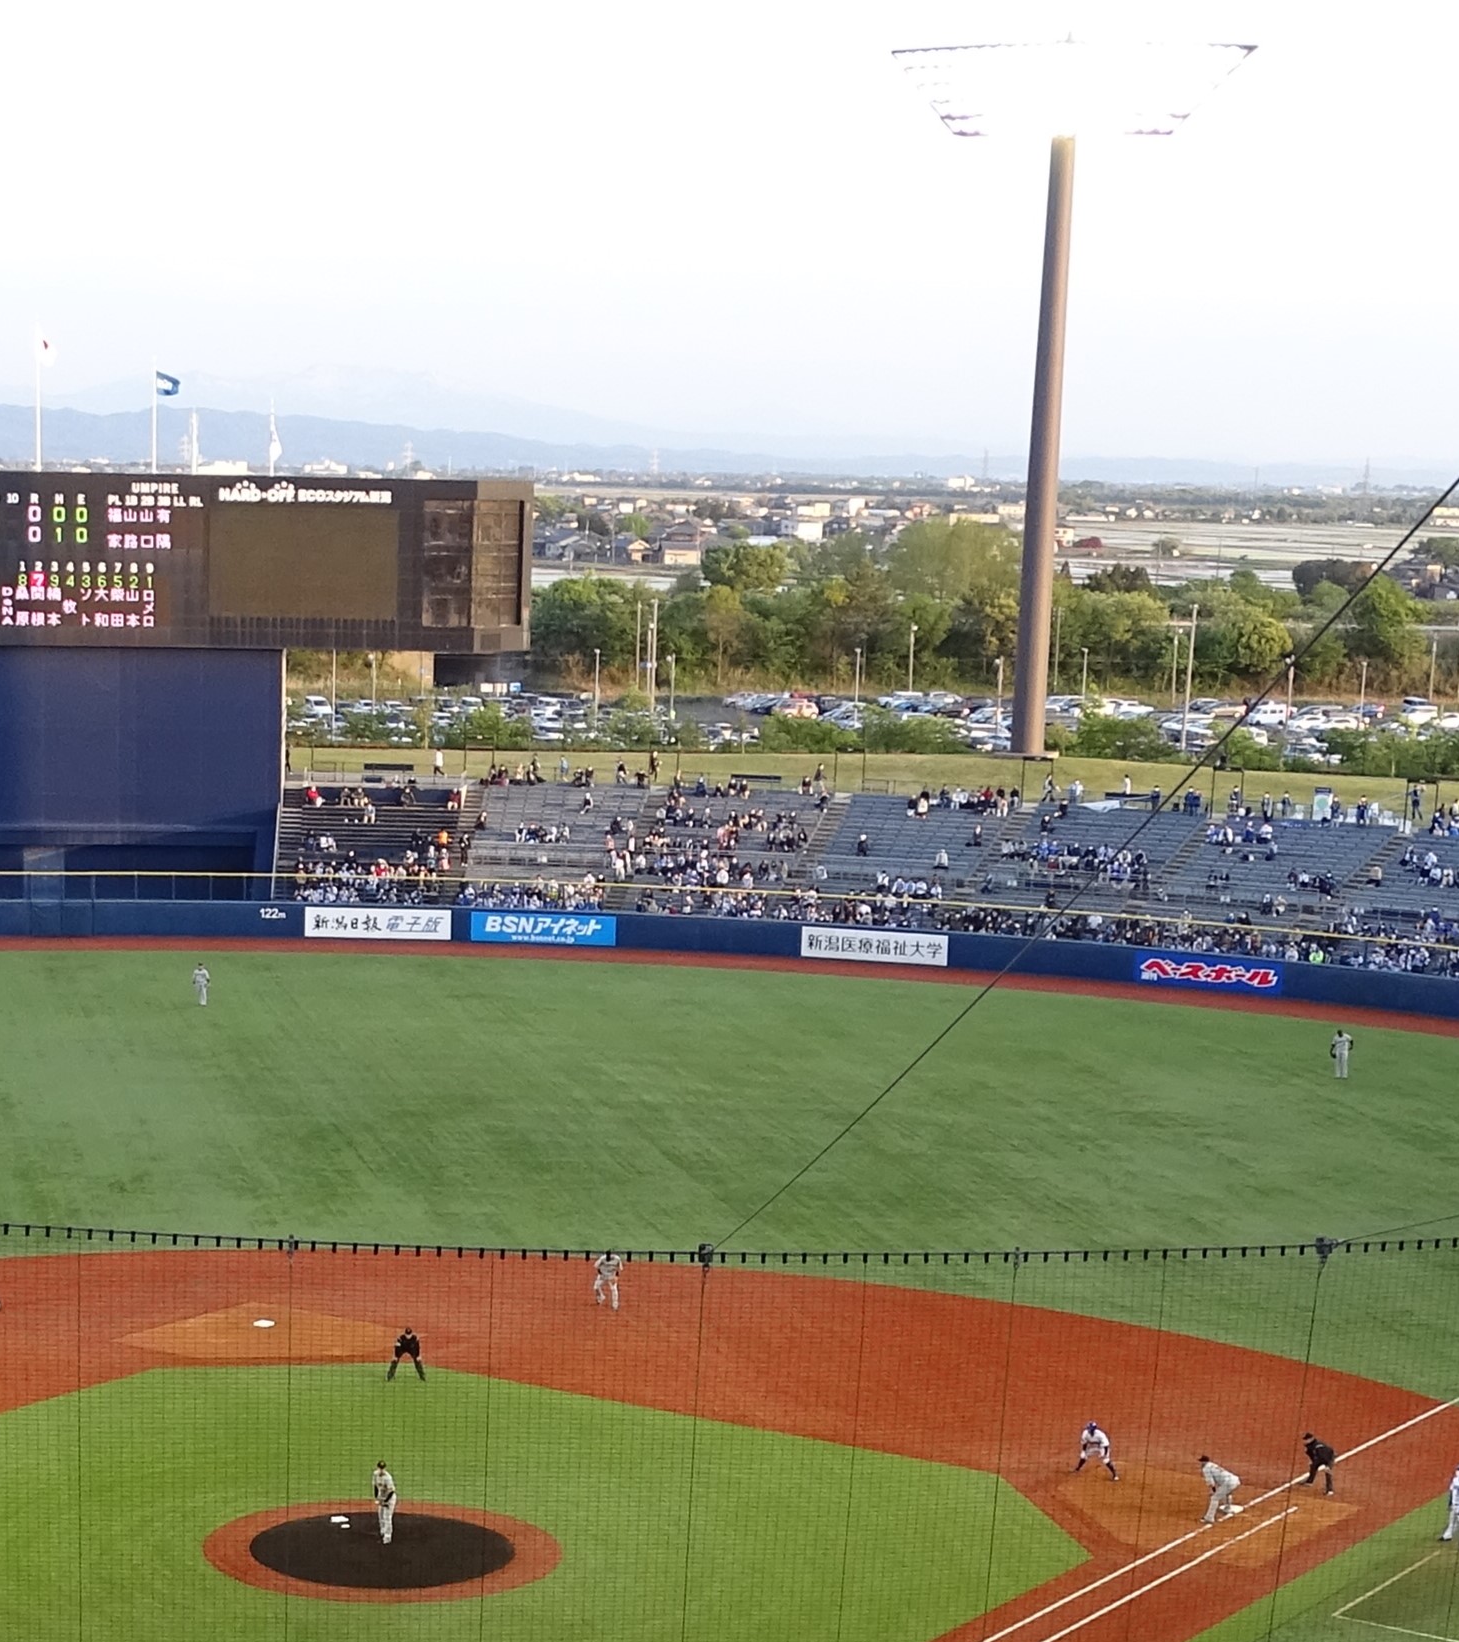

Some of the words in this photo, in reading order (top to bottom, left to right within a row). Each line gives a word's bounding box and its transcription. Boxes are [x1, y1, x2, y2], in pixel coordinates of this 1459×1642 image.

[131, 482, 179, 494] UMPIRE
[6, 492, 20, 504] 10
[30, 493, 39, 504] R
[55, 493, 64, 504] H
[77, 493, 86, 505] E
[107, 494, 122, 506] PL
[28, 505, 42, 523] 0
[52, 506, 66, 523] 0
[75, 507, 88, 523] 0
[28, 526, 42, 543] 0
[55, 527, 64, 543] 1
[75, 527, 88, 543] 0
[19, 561, 27, 572] 1
[35, 561, 43, 572] 2
[51, 561, 59, 572] 3
[66, 561, 75, 572] 4
[82, 562, 91, 573] 5
[98, 562, 107, 573] 6
[114, 562, 122, 573] 7
[130, 562, 138, 573] 8
[145, 563, 154, 574] 9
[18, 574, 28, 587] 8
[33, 574, 44, 587] 7
[49, 574, 59, 587] 9
[66, 574, 75, 587] 4
[82, 574, 91, 587] 3
[97, 574, 107, 587] 6
[113, 575, 123, 588] 5
[129, 575, 139, 588] 2
[146, 575, 153, 588] 1
[260, 908, 286, 918] 122m
[485, 915, 602, 936] BSNアイネット
[808, 933, 943, 959] 新潟医療福祉大学
[1140, 958, 1278, 988] ベースボール
